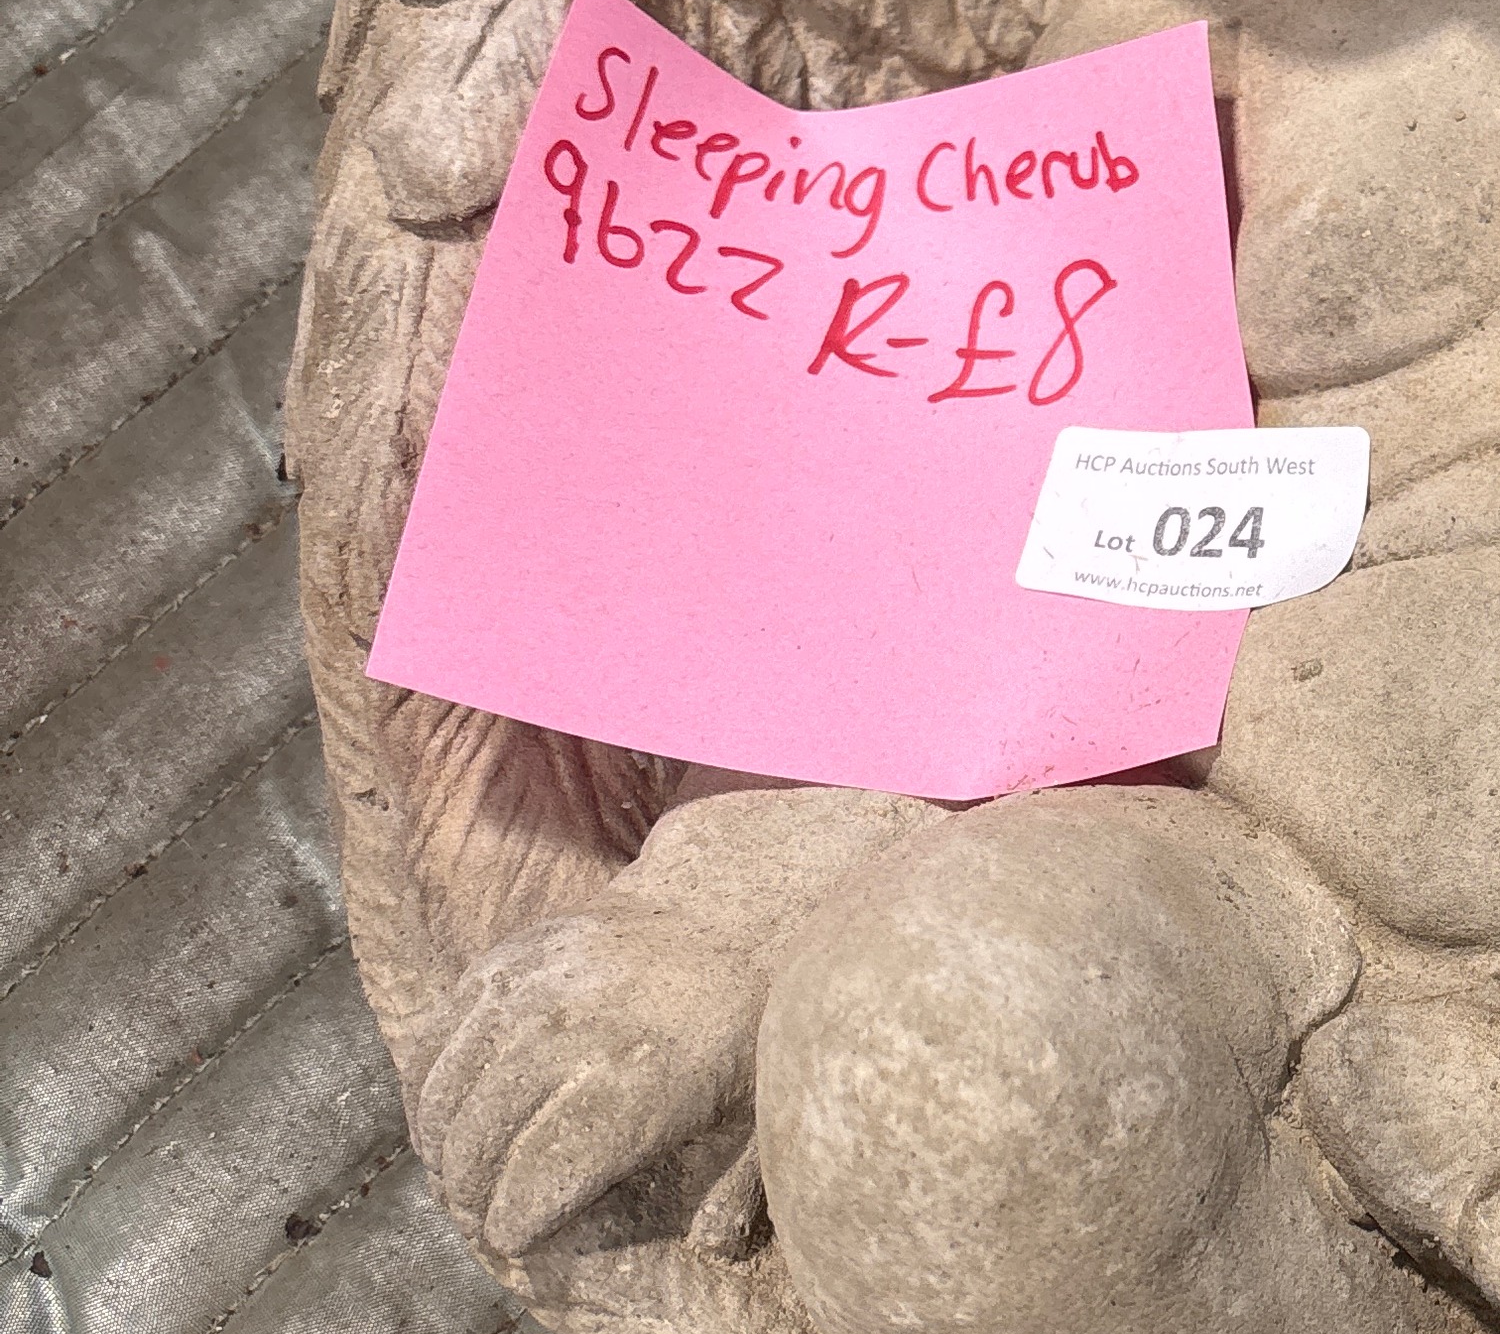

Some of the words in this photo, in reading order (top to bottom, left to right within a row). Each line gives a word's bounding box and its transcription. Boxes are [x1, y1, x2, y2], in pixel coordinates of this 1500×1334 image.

[575, 46, 887, 258] Sleeping
[916, 131, 1140, 212] Cherub
[1075, 453, 1116, 473] HCP
[1120, 457, 1202, 477] Auctions
[1206, 457, 1259, 475] South
[1266, 456, 1316, 475] West
[1093, 529, 1136, 553] Lot
[1152, 506, 1265, 559] 024
[1074, 570, 1264, 599] www.hcpauctions.net
